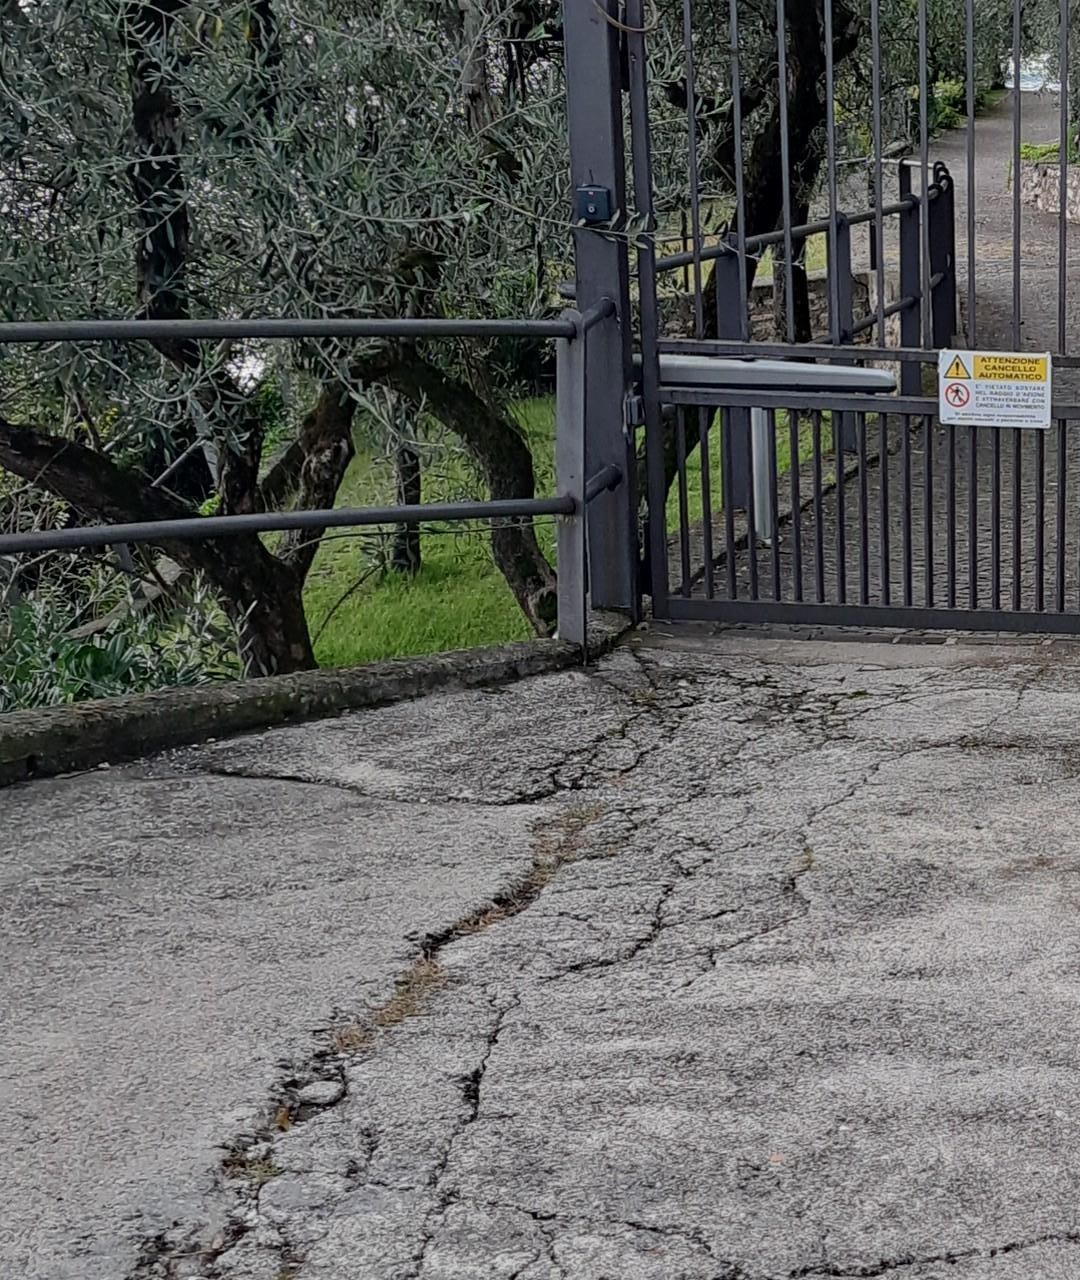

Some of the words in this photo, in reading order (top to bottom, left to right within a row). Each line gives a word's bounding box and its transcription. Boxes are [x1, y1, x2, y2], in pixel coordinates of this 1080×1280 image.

[980, 357, 1041, 365] ATTENZIONE
[984, 364, 1037, 372] CANCELLO
[978, 372, 1042, 380] AUTOMATICO
